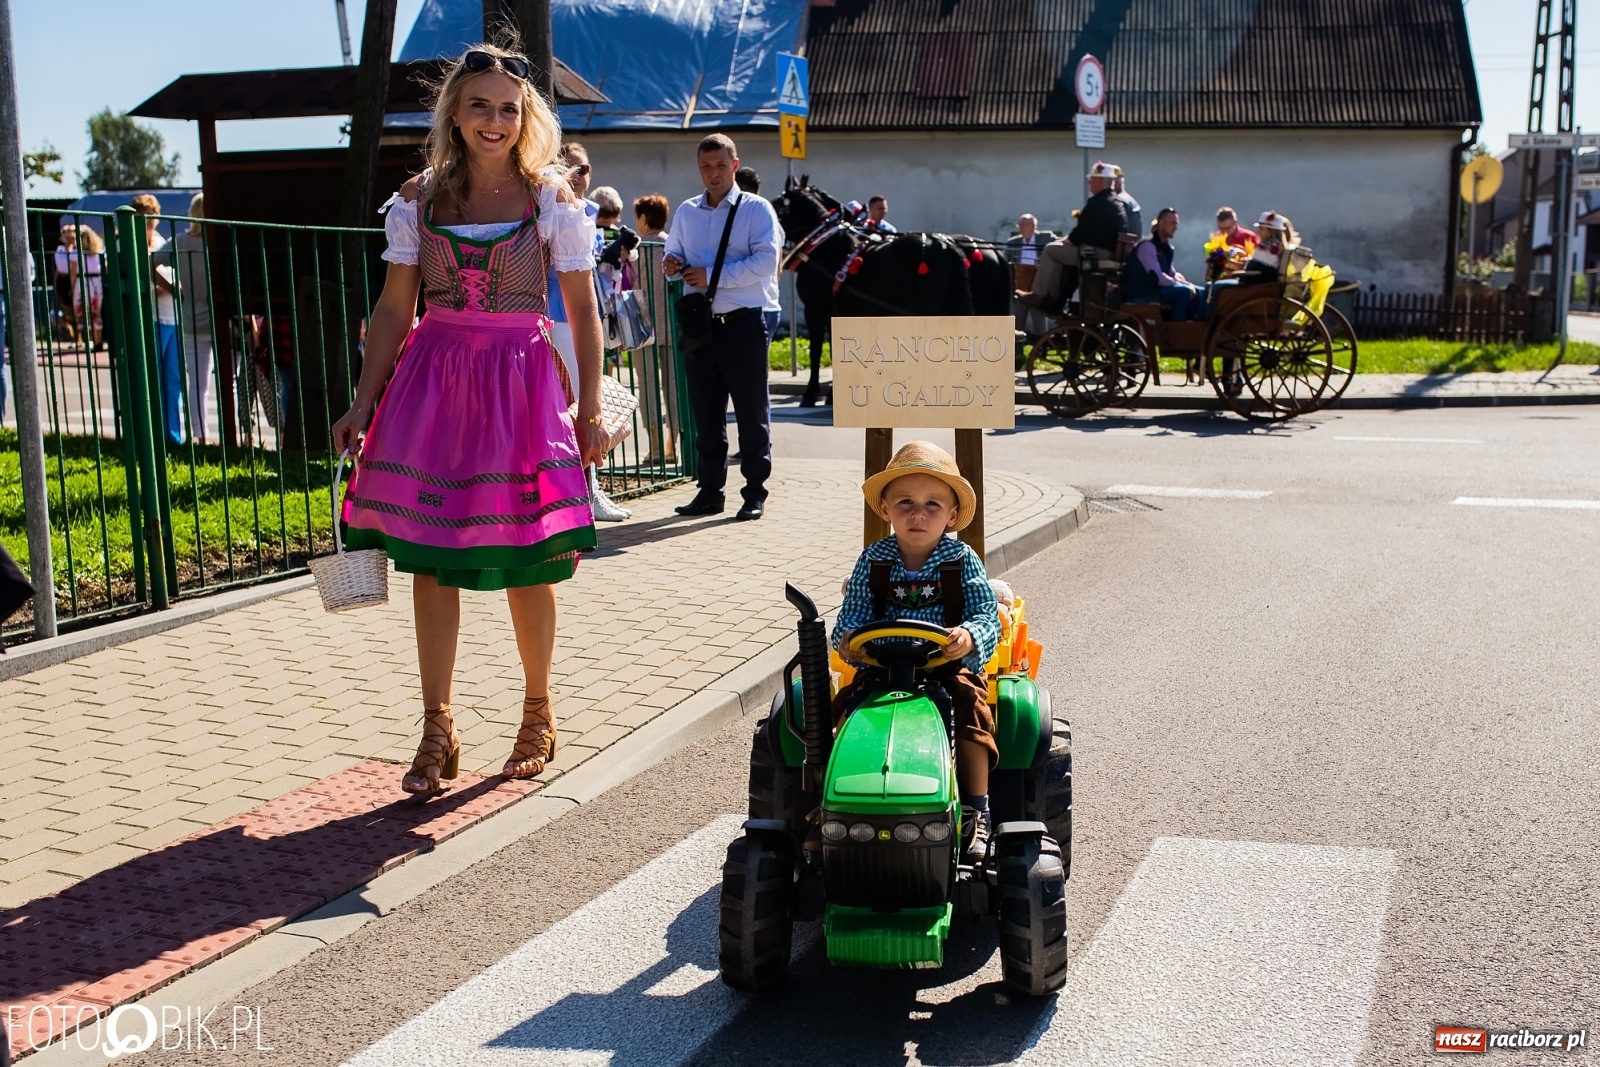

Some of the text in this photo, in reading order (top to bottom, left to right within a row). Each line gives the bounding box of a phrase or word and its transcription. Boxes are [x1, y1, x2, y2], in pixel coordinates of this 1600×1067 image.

[840, 335, 1007, 369] RANCHO
[848, 380, 1000, 407] U GALDY
